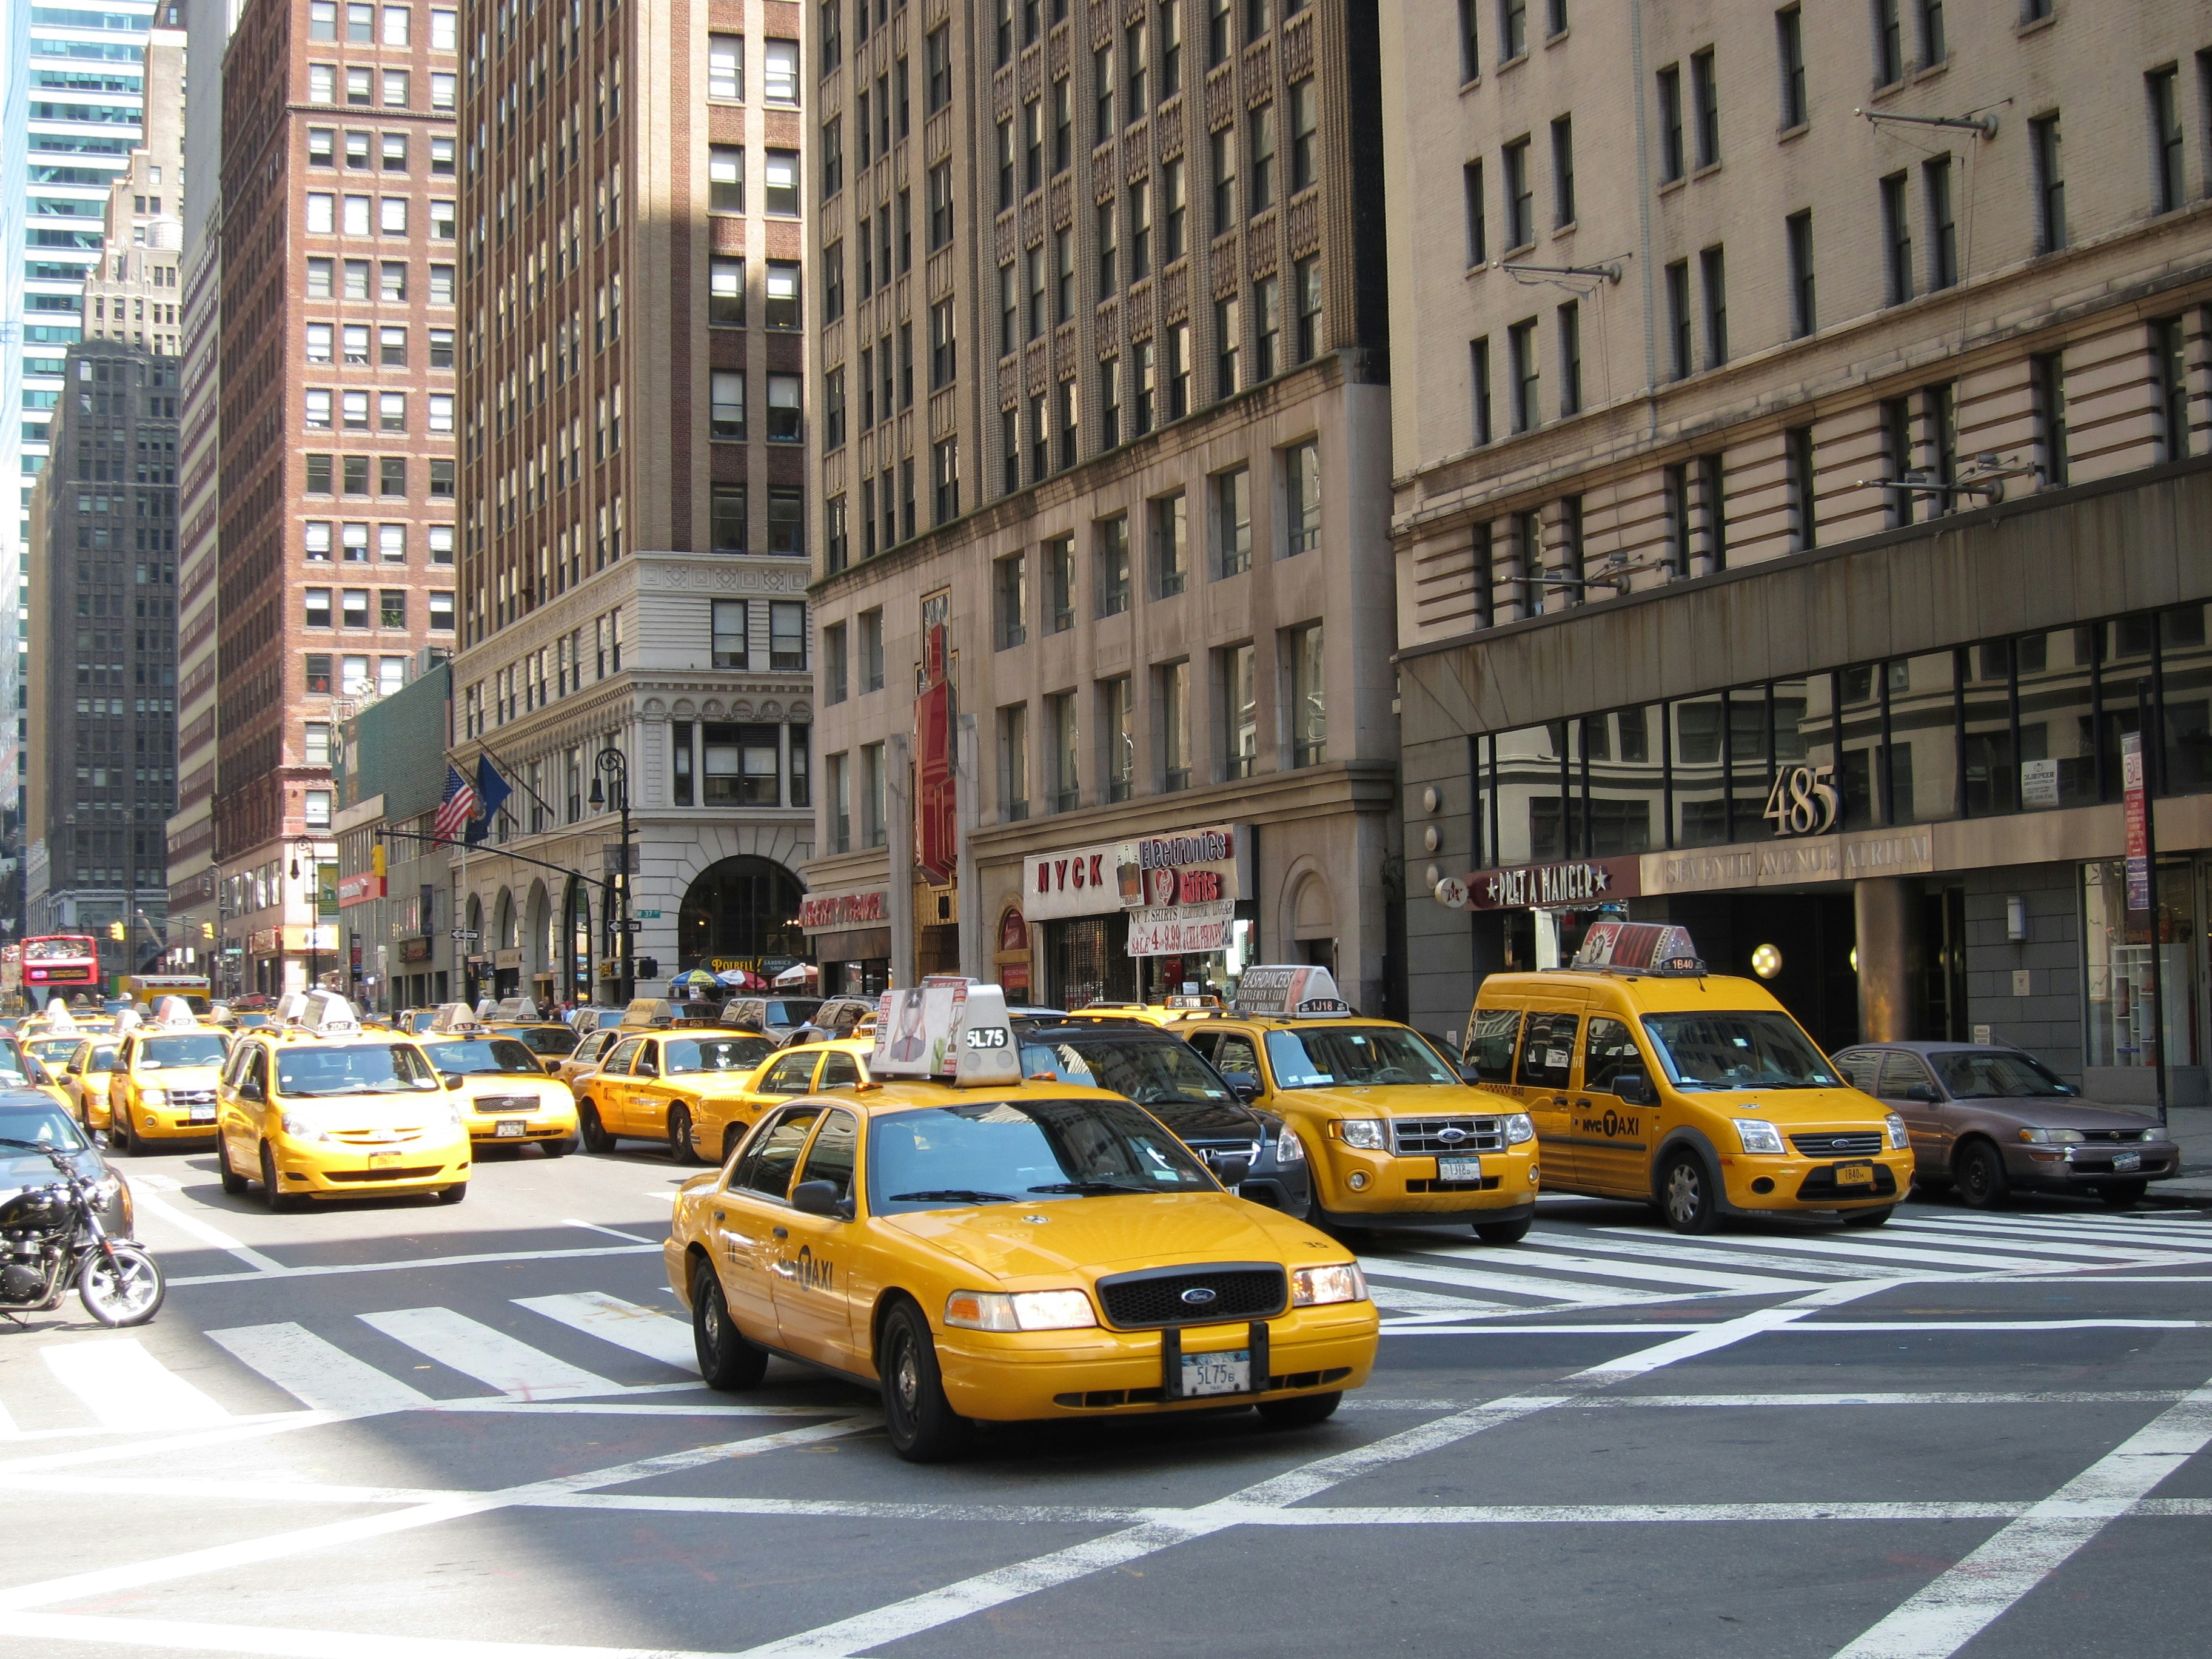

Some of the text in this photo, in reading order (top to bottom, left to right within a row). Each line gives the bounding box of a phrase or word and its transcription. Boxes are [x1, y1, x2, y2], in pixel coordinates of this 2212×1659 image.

[1763, 765, 1840, 836] 485
[1140, 830, 1229, 871] Electronics
[1665, 836, 1928, 883] SEVENTH AVENUE ATRIUM
[1037, 854, 1103, 893] NYCK
[1180, 871, 1221, 903] Gifts
[1499, 863, 1594, 905] PRET A MANGER
[799, 899, 841, 927] LIBERTY
[1131, 937, 1150, 954] SALE
[1152, 927, 1159, 950] 4
[1672, 959, 1693, 969] 1B40
[1240, 971, 1293, 988] FLASHDANCERS
[1185, 998, 1201, 1007] 1T80
[1237, 989, 1287, 1000] GENTLEMEN'S CLUB
[1256, 1002, 1280, 1011] BROADWAY
[1312, 1001, 1333, 1011] 1J18
[689, 1019, 704, 1028] 4G26
[967, 1029, 1005, 1048] 5L75
[1583, 1119, 1602, 1133] NYC
[1189, 1292, 1208, 1300] Ford
